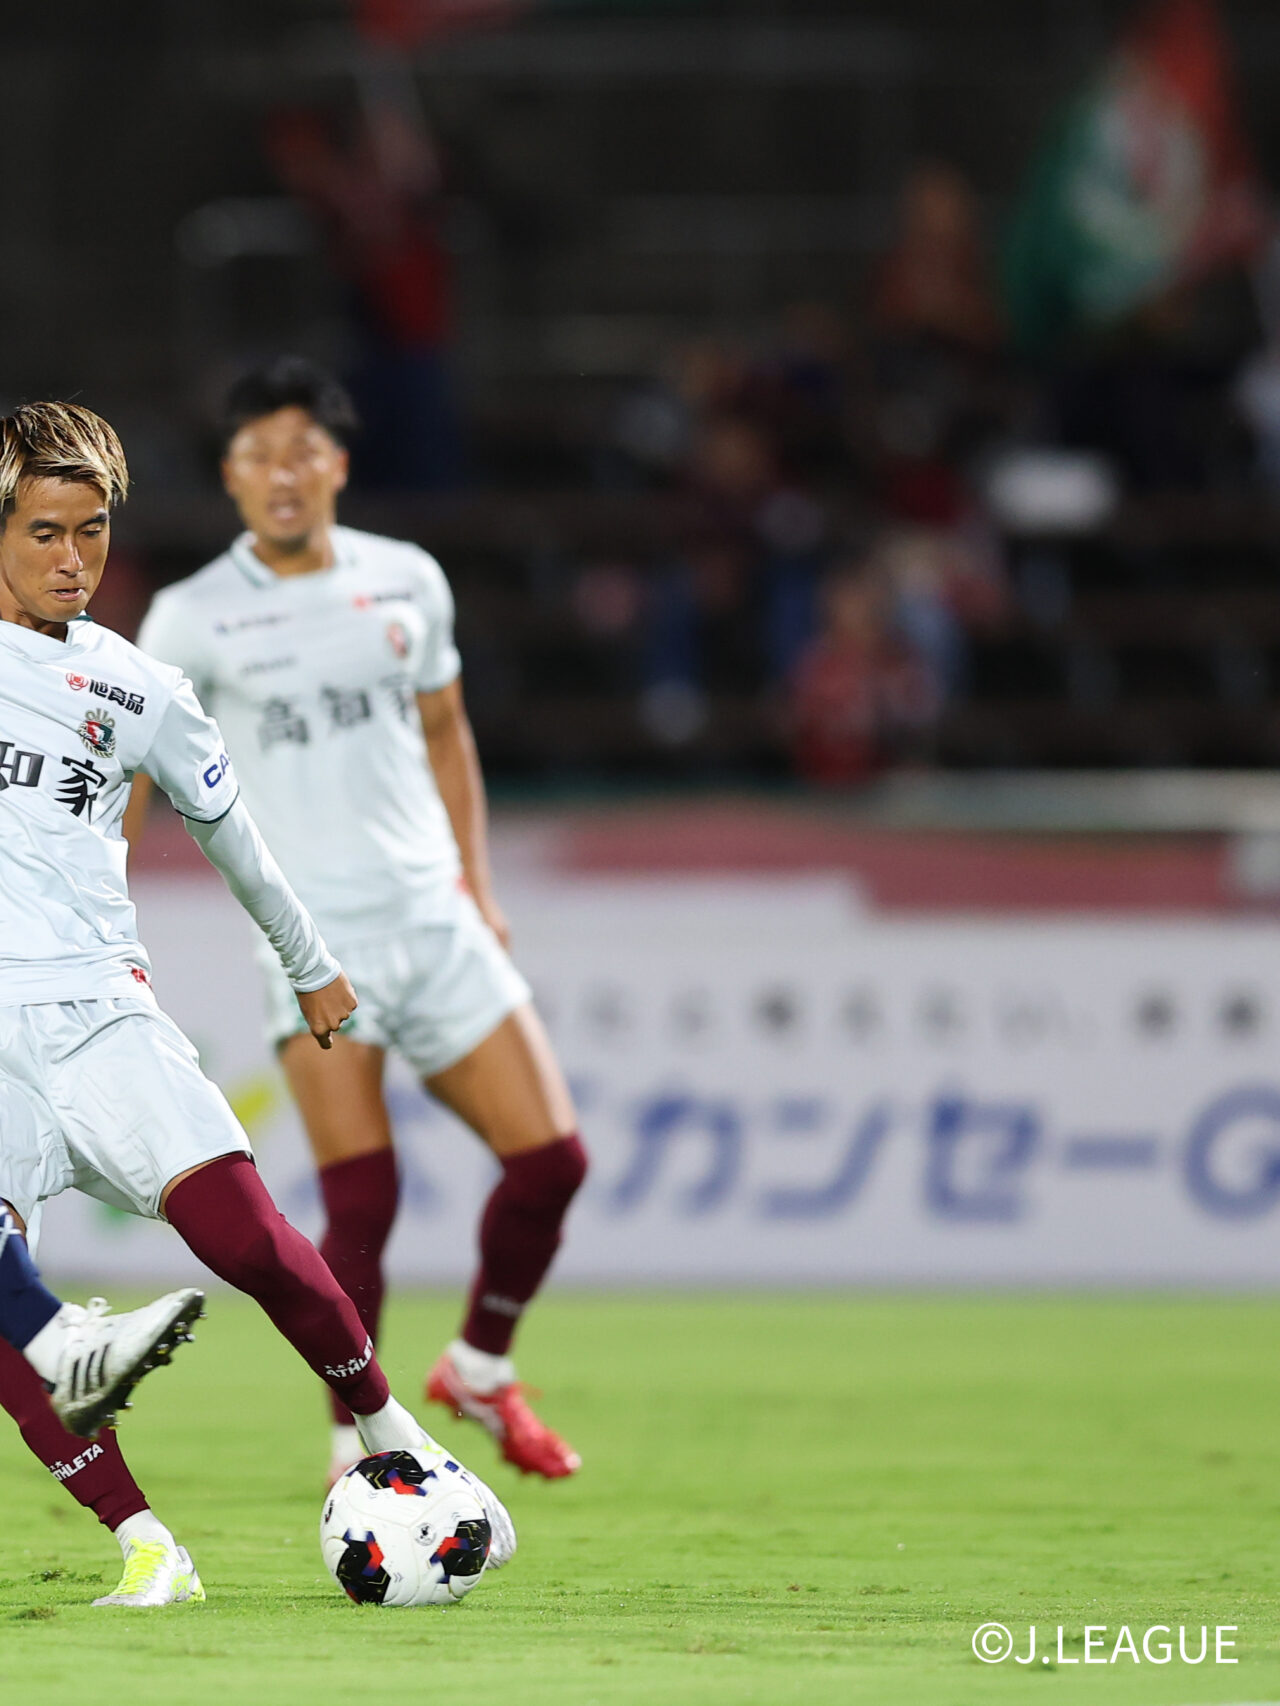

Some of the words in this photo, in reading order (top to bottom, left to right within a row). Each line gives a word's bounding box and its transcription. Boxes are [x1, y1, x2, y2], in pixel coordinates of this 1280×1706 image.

[89, 678, 145, 715] 旭食品
[203, 748, 230, 788] CA
[52, 1443, 104, 1481] THLETA
